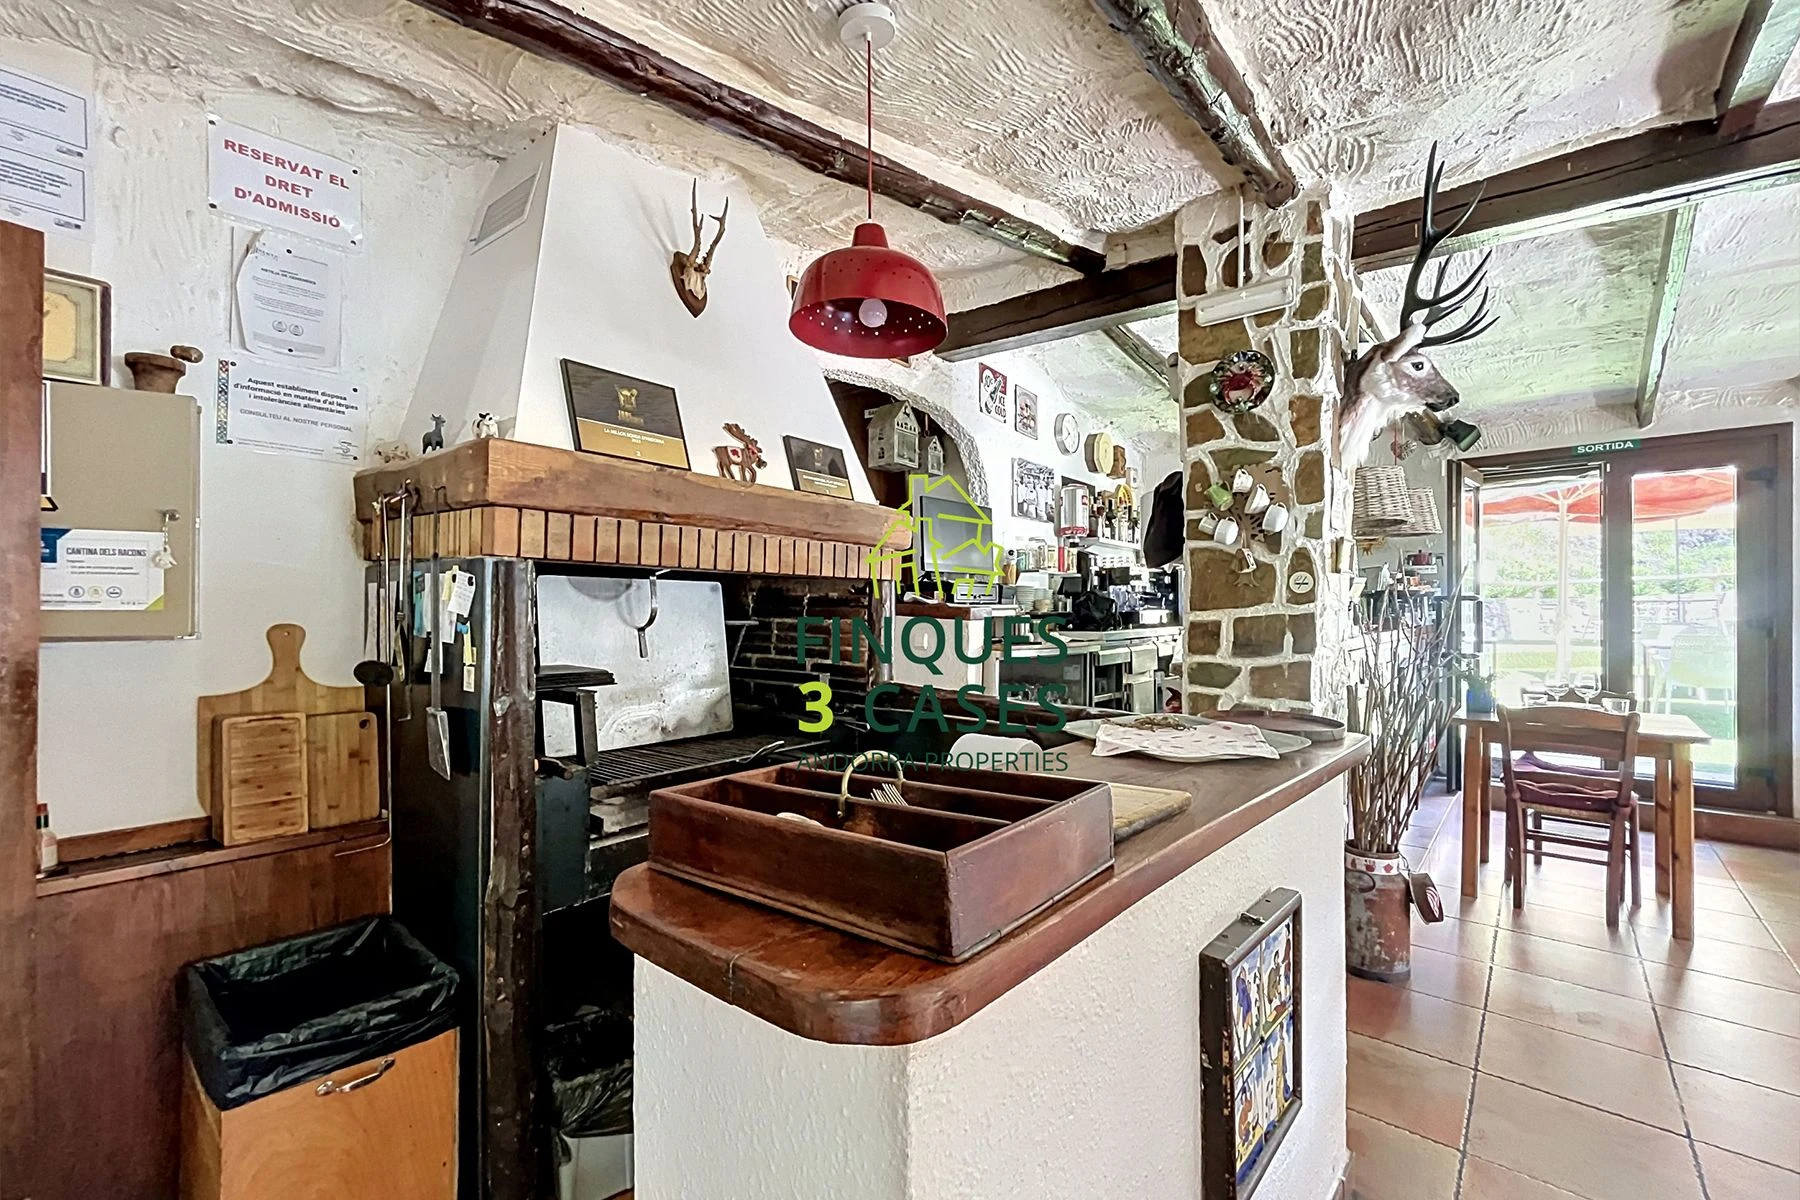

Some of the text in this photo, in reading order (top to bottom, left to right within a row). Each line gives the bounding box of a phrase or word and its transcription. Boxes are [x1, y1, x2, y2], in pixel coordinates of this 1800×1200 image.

[223, 139, 350, 190] RESERVAT EL
[265, 175, 313, 198] DRET
[248, 377, 347, 401] Aquest establiment disposa
[239, 408, 282, 420] CONSULTEU
[293, 417, 319, 427] NOSTRE
[320, 422, 353, 432] PERSONAL
[1577, 441, 1634, 453] SORTIDA
[66, 547, 147, 557] CANTINA DELS RACONS
